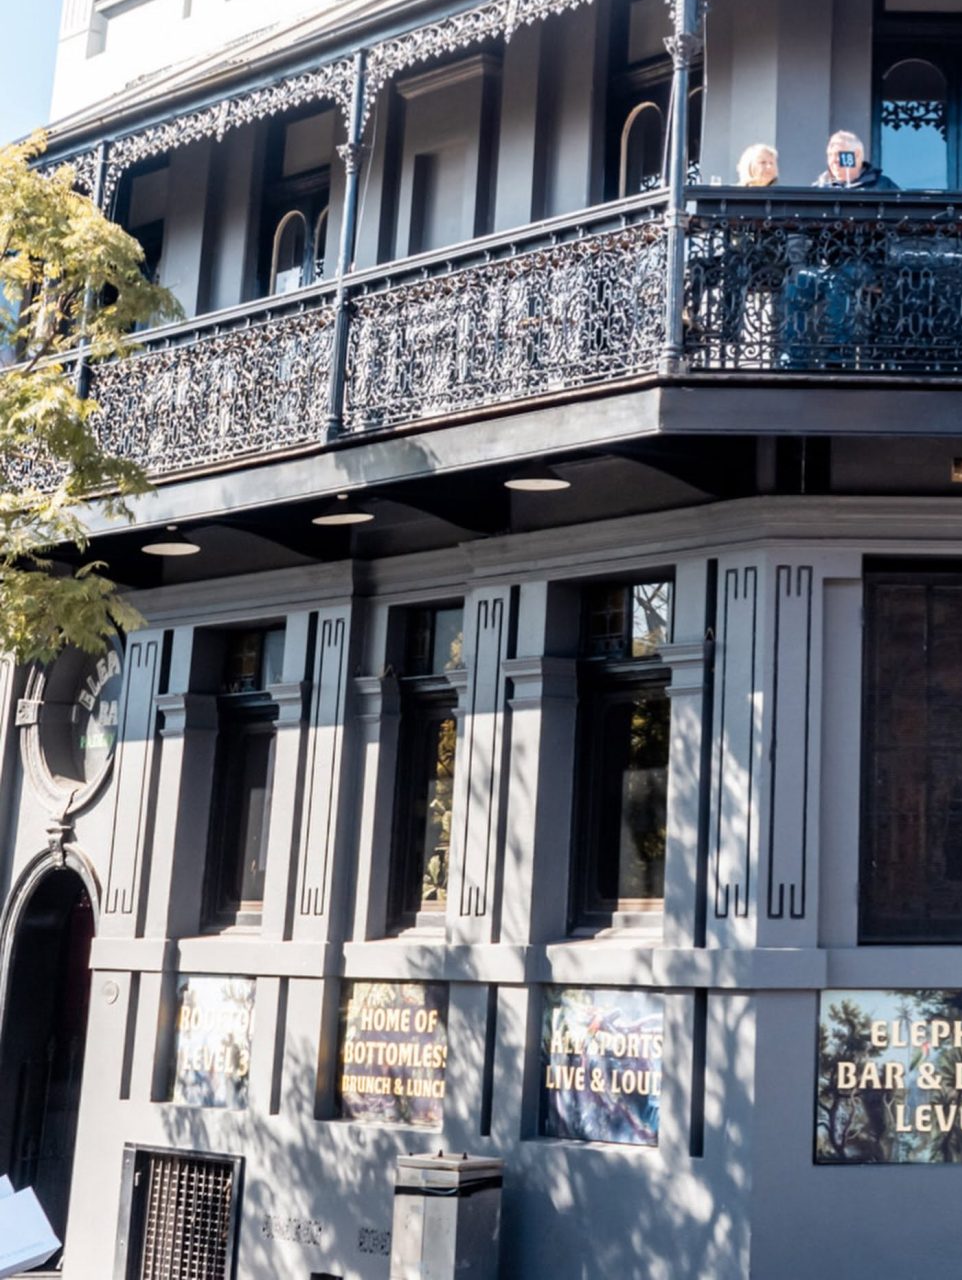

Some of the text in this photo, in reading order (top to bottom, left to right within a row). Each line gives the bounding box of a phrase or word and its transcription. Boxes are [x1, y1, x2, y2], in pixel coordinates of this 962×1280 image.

[841, 153, 854, 166] 18
[361, 1007, 438, 1033] HOME OF
[586, 1031, 663, 1058] SPORTS
[236, 1049, 249, 1076] 3
[837, 1061, 904, 1090] BAR
[916, 1063, 942, 1090] &
[342, 1075, 391, 1094] BRUNCH
[394, 1078, 403, 1096] &
[545, 1065, 586, 1091] LIVE
[590, 1067, 605, 1092] &
